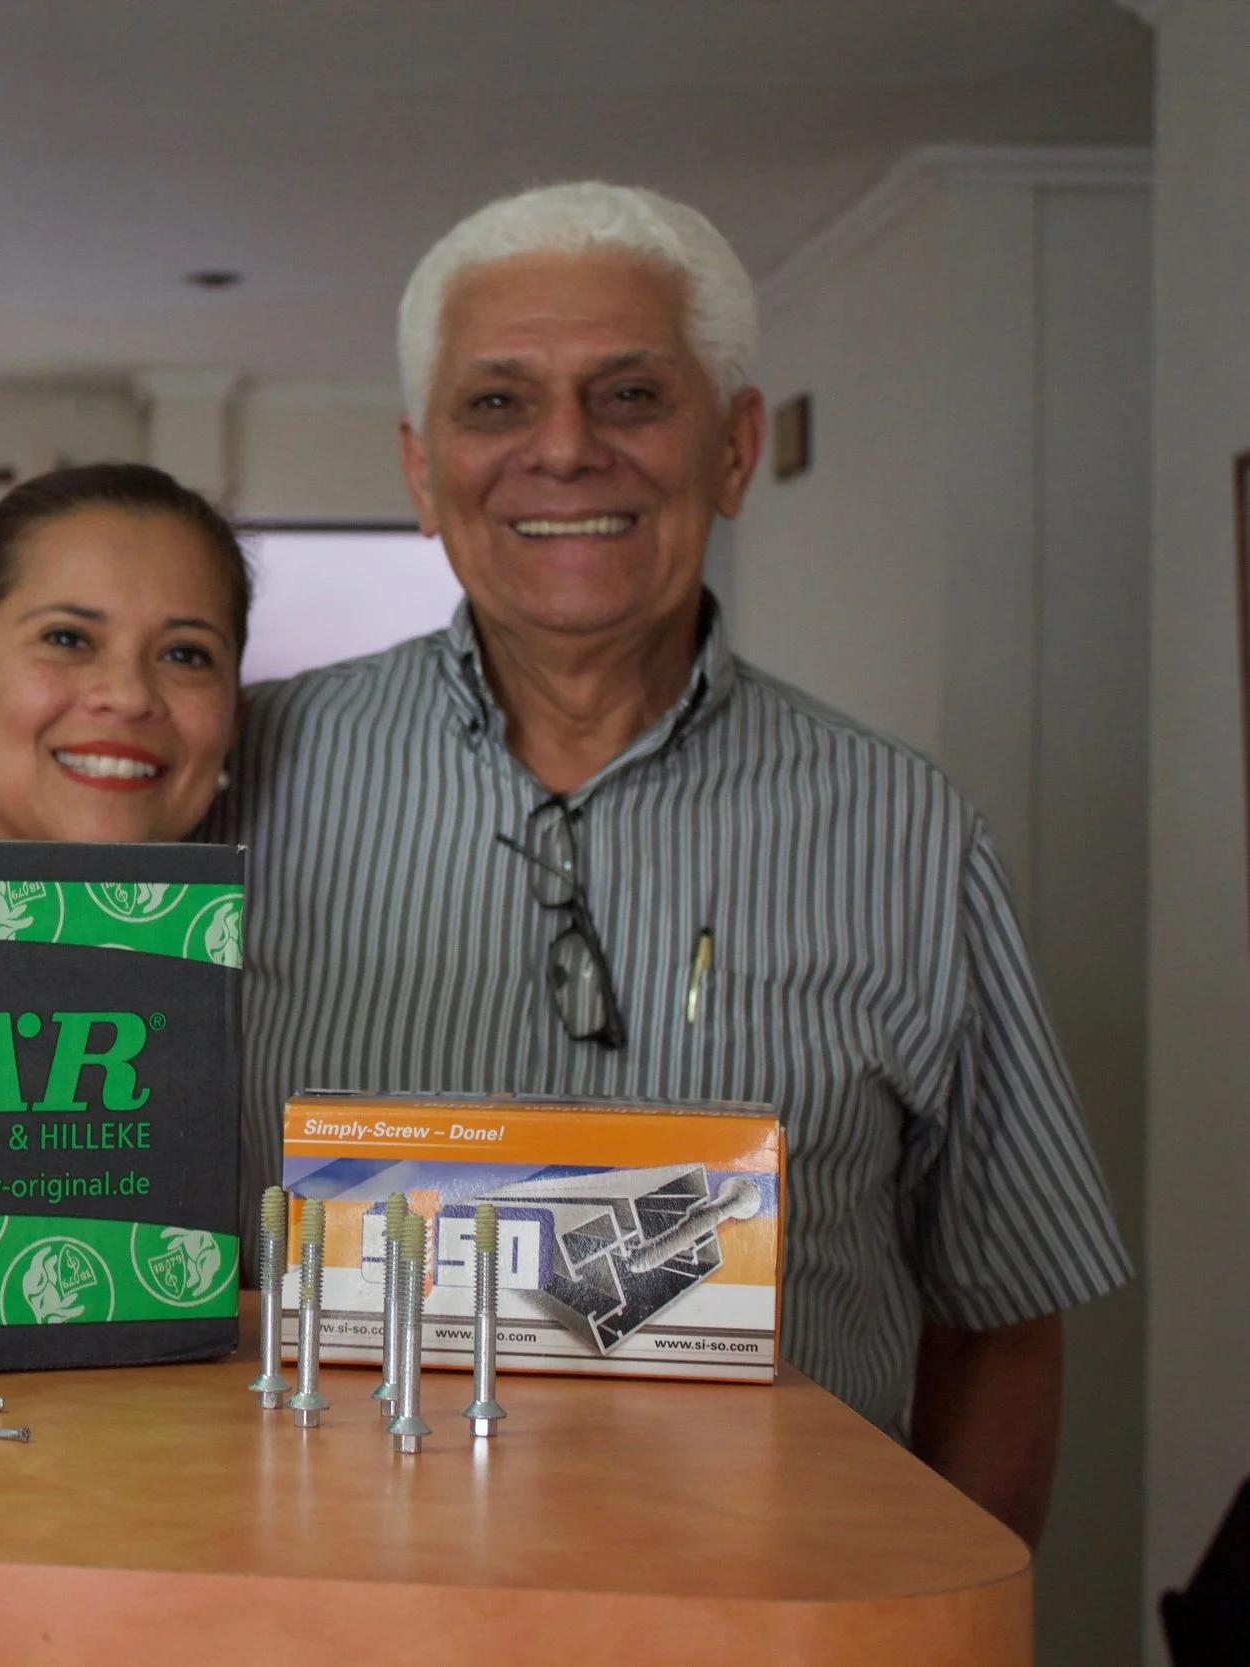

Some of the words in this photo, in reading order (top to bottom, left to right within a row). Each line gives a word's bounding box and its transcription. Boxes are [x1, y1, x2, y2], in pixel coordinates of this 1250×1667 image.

[8, 1123, 29, 1150] &
[41, 1122, 151, 1150] HILLEKE
[303, 1118, 431, 1141] Simply-Screw
[449, 1124, 506, 1142] Done!
[654, 1337, 759, 1355] www.si-so.com
